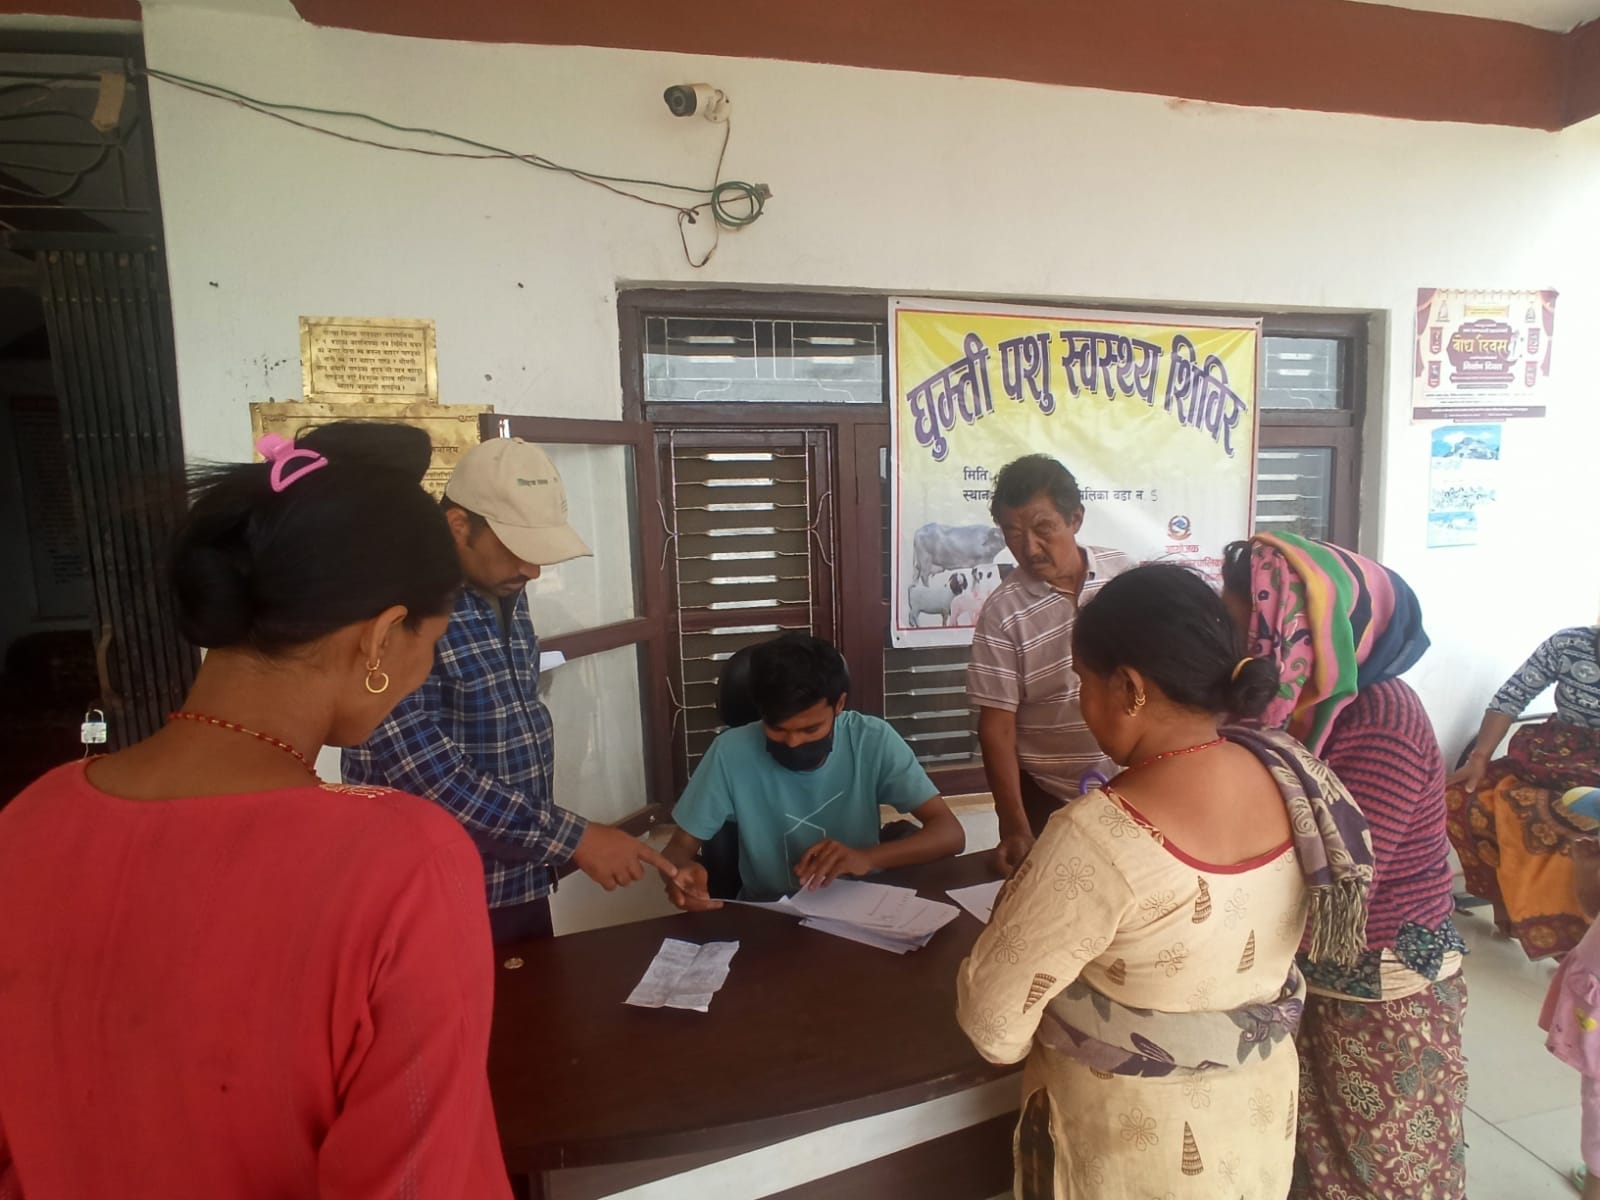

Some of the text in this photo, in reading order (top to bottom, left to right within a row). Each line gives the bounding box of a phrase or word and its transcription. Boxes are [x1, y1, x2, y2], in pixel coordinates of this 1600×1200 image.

[907, 332, 994, 461] घुम्ती
[998, 332, 1056, 416] पशु
[1163, 333, 1249, 458] शिविर
[1112, 489, 1133, 502] वडा
